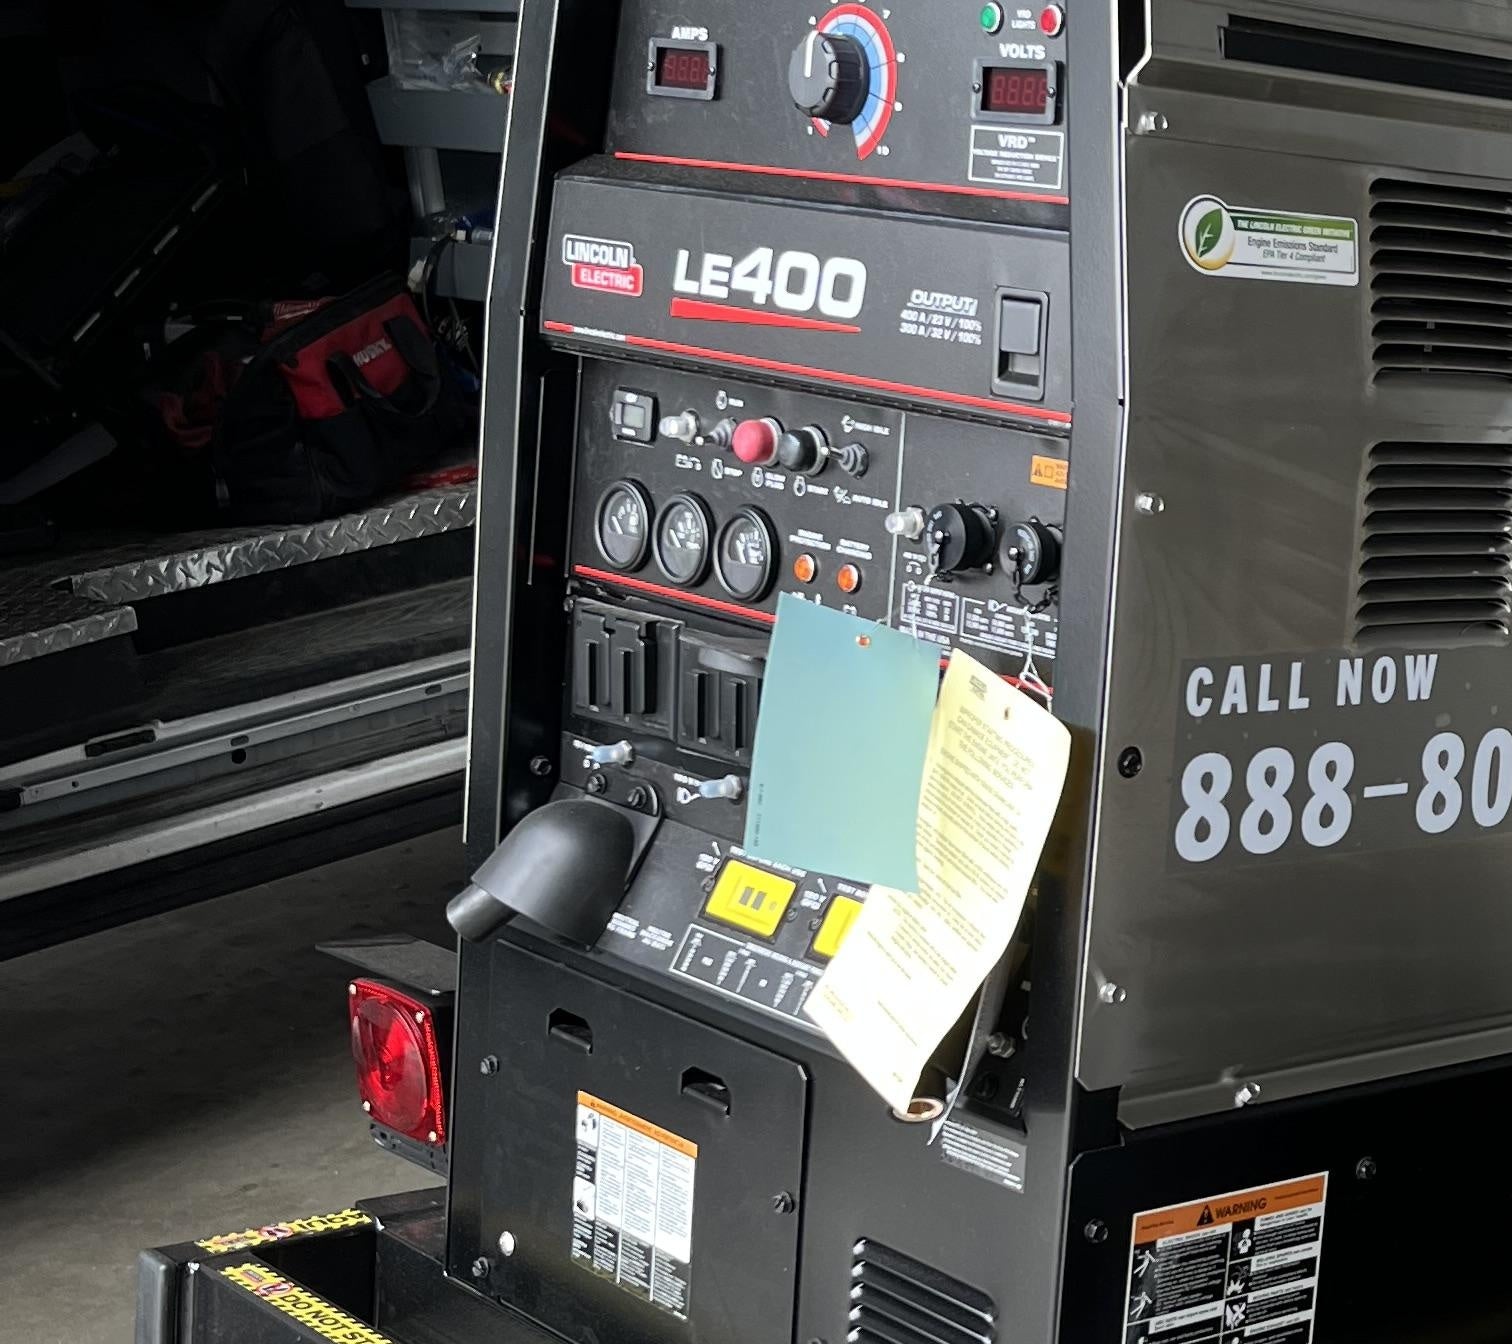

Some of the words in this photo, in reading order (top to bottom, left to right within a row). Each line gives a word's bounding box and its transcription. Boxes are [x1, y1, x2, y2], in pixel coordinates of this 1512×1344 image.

[671, 26, 709, 41] AMPS
[1000, 43, 1046, 60] VOLTS
[566, 240, 630, 268] LINCOLN
[1247, 236, 1271, 248] Engine
[1273, 238, 1307, 250] Emissions
[1308, 241, 1338, 253] Standard
[580, 266, 635, 290] ELECTRIC
[673, 247, 867, 318] LE400
[1186, 661, 1310, 717] CALL
[1336, 654, 1438, 705] NOW
[1215, 1197, 1268, 1220] WARNING
[280, 1294, 313, 1311] DO
[307, 1310, 351, 1331] NOT
